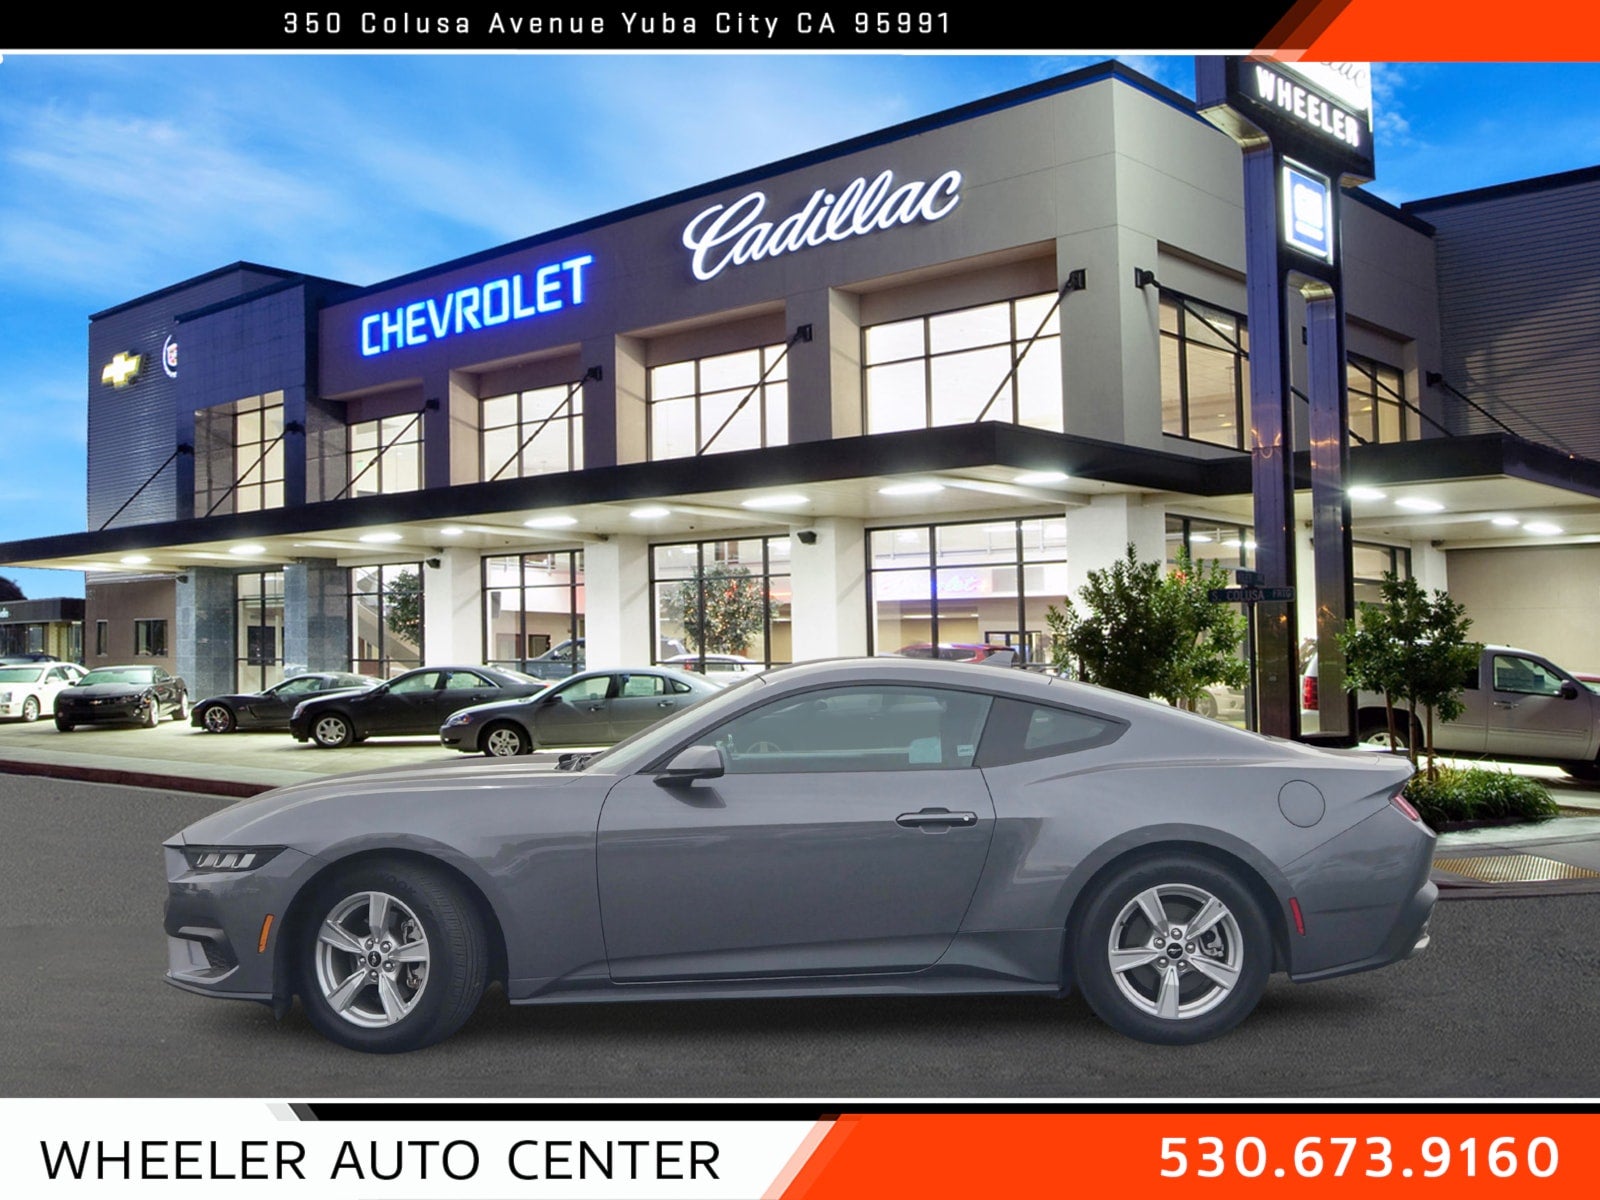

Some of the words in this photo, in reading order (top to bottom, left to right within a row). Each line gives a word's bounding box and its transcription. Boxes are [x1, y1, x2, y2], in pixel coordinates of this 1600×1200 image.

[1255, 65, 1360, 148] WHEELER
[682, 169, 962, 281] Cadillac
[361, 254, 593, 357] CHEVROLET
[1226, 589, 1265, 601] COLUSA
